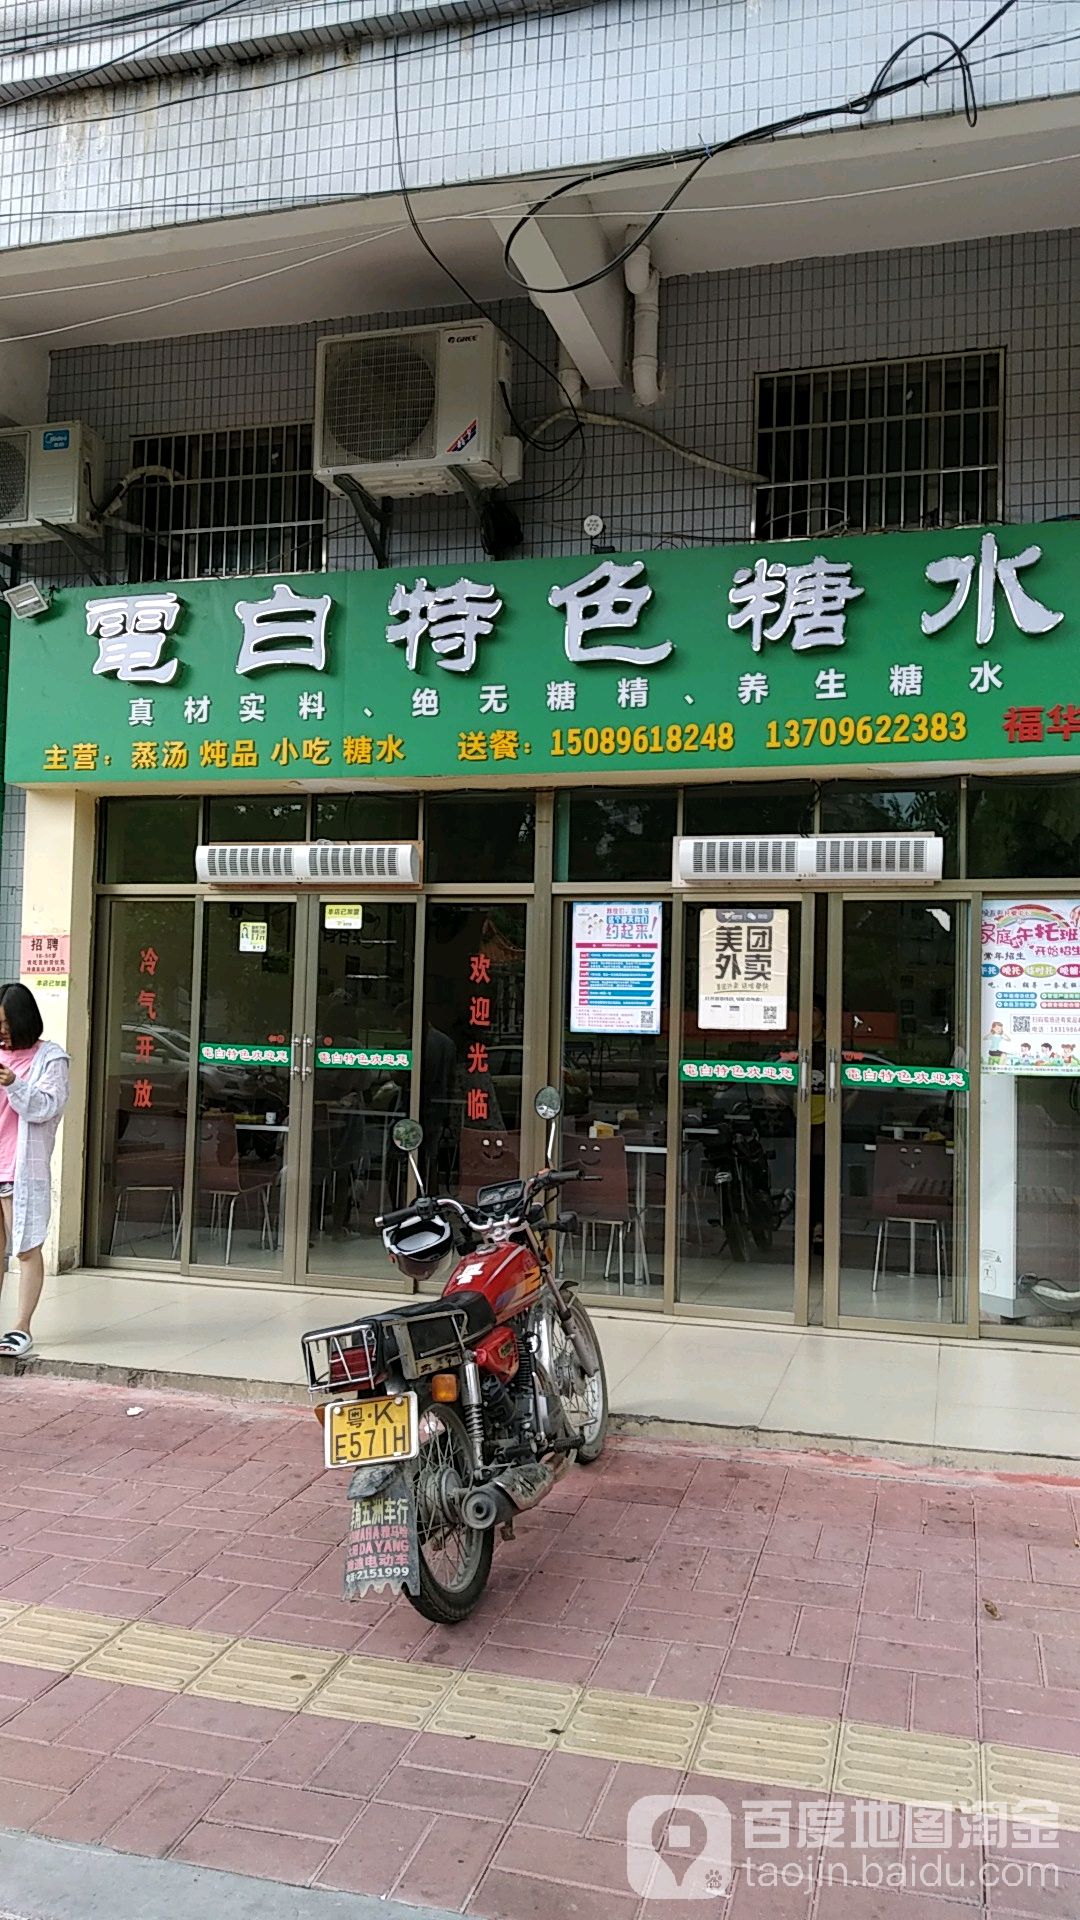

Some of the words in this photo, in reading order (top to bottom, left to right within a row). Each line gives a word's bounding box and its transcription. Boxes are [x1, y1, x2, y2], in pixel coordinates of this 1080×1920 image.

[85, 533, 1065, 684] 電白特色糖水
[128, 661, 1004, 727] 真材实料、绝无糖精、养生糖水
[131, 741, 188, 768] 蒸汤
[200, 738, 258, 768] 炖品
[271, 738, 331, 766] 小吃
[343, 734, 405, 764] 糖水
[551, 722, 734, 756] 15089618248
[766, 712, 966, 749] 13709622383
[31, 938, 58, 951] 招聘
[715, 954, 771, 980] 外卖
[716, 925, 773, 952] 美团
[133, 947, 160, 1108] 冷气开放
[467, 953, 491, 1121] 欢迎光临
